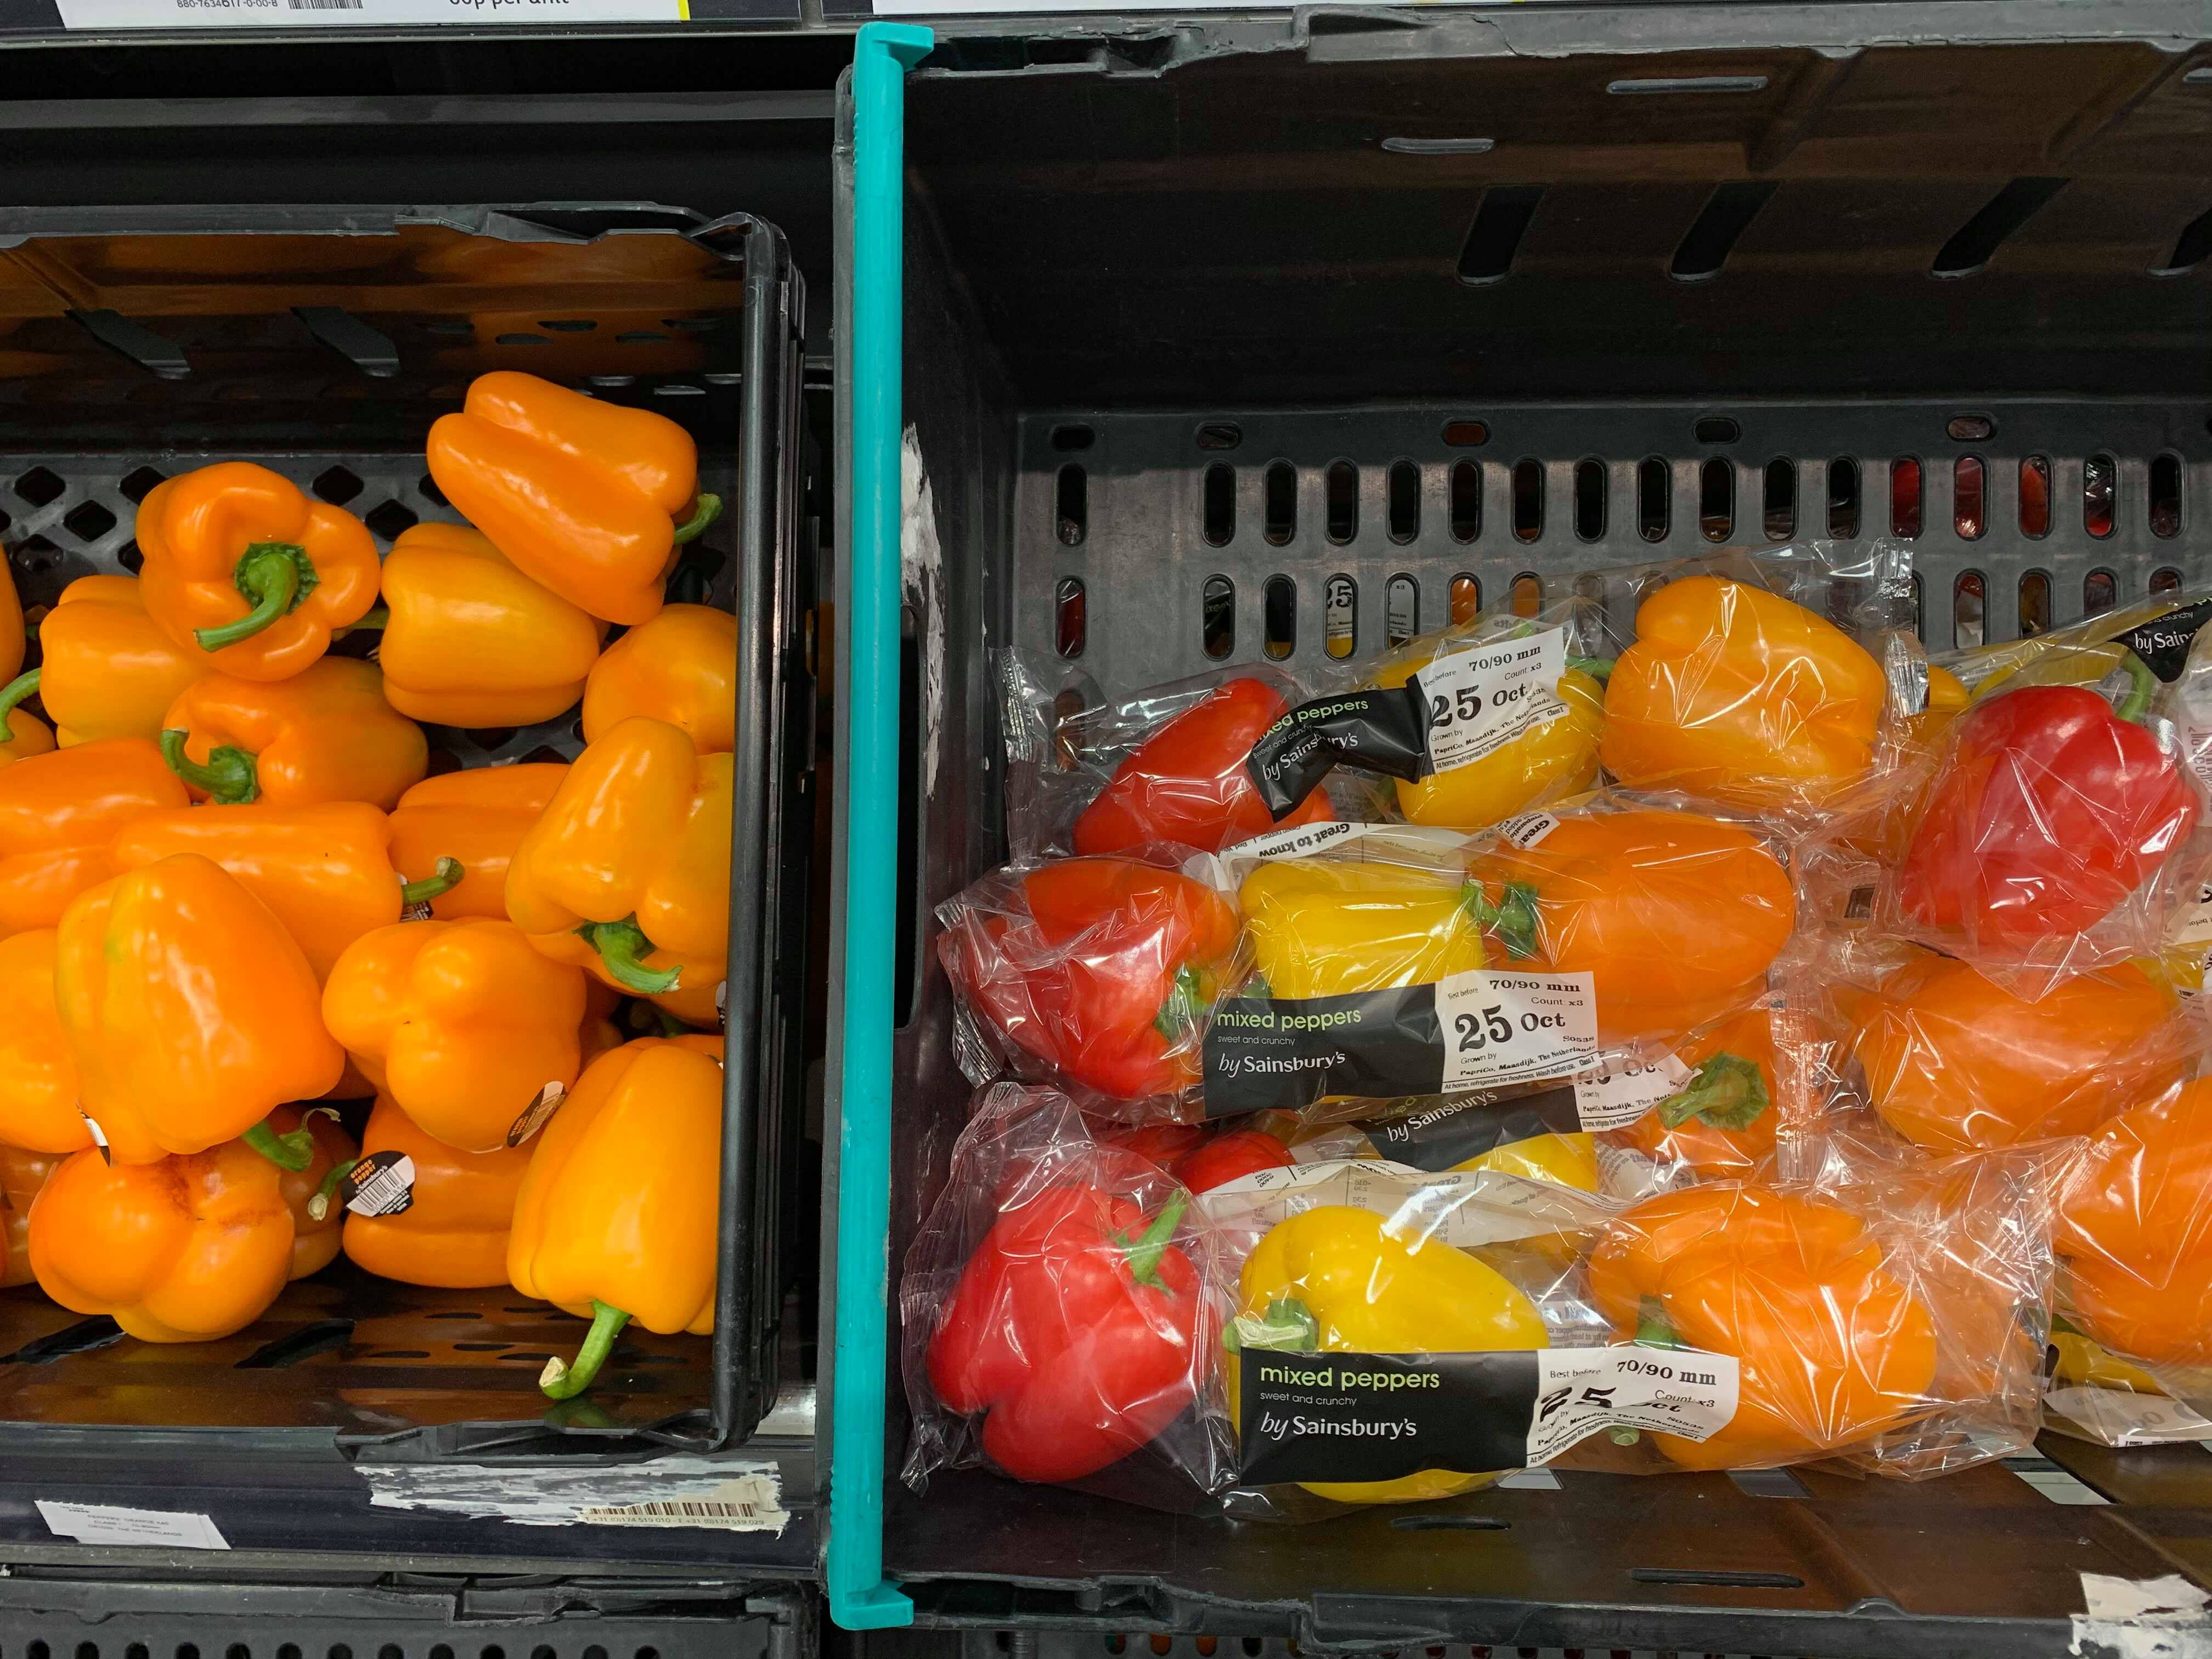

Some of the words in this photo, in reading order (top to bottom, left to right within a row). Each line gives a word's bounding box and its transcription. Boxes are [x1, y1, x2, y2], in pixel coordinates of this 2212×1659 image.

[2135, 633, 2152, 654] by
[1469, 654, 1512, 671] 70/90
[1517, 646, 1541, 660] mm
[1531, 663, 1542, 672] x3
[1435, 670, 1457, 681] before
[1297, 701, 1368, 722] peppers
[1430, 685, 1481, 730] 25
[1492, 683, 1528, 707] Oct
[1500, 719, 1514, 729] The
[1431, 732, 1453, 742] Grown
[1458, 749, 1482, 764] refrigerate
[1547, 707, 1559, 716] Class
[1253, 744, 1273, 759] sweet
[1273, 737, 1286, 748] and
[1262, 764, 1280, 781] by
[1297, 836, 1313, 847] to
[1316, 823, 1350, 843] Great
[1259, 841, 1297, 856] know
[1460, 988, 1478, 997] before
[1489, 979, 1539, 990] 70/90
[1547, 983, 1581, 991] mm
[1531, 997, 1566, 1006] Count:
[1217, 1011, 1274, 1028] mixed
[1282, 1009, 1361, 1031] peppers
[1455, 1005, 1512, 1052] 25
[1521, 1013, 1566, 1031] Oct
[1261, 1037, 1295, 1046] crunchy
[1218, 1053, 1240, 1078] by
[1244, 1051, 1346, 1073] Sainsbury's
[1460, 1067, 1496, 1076] PapriCo,
[1499, 1057, 1536, 1070] Maasdijk,
[1461, 1054, 1486, 1064] Grown
[1488, 1052, 1496, 1060] by
[1508, 1074, 1534, 1082] freshness.
[1602, 1102, 1634, 1111] Maasdijk,
[1387, 1124, 1409, 1142] by
[1408, 1091, 1497, 1130] Sainsbury's
[351, 1159, 373, 1178] orange
[354, 1164, 375, 1184] pepper
[1261, 1366, 1332, 1387] mixed
[1341, 1371, 1440, 1391] peppers
[1617, 1360, 1672, 1379] 70/90
[1679, 1371, 1717, 1385] mm
[1261, 1392, 1289, 1401] sweet
[1293, 1395, 1313, 1404] and
[1316, 1396, 1357, 1407] crunchy
[1539, 1387, 1616, 1423] 25
[1631, 1402, 1681, 1413] ct
[1560, 1409, 1570, 1420] by
[1260, 1412, 1289, 1440] by
[1293, 1416, 1417, 1440] Sainsbury's
